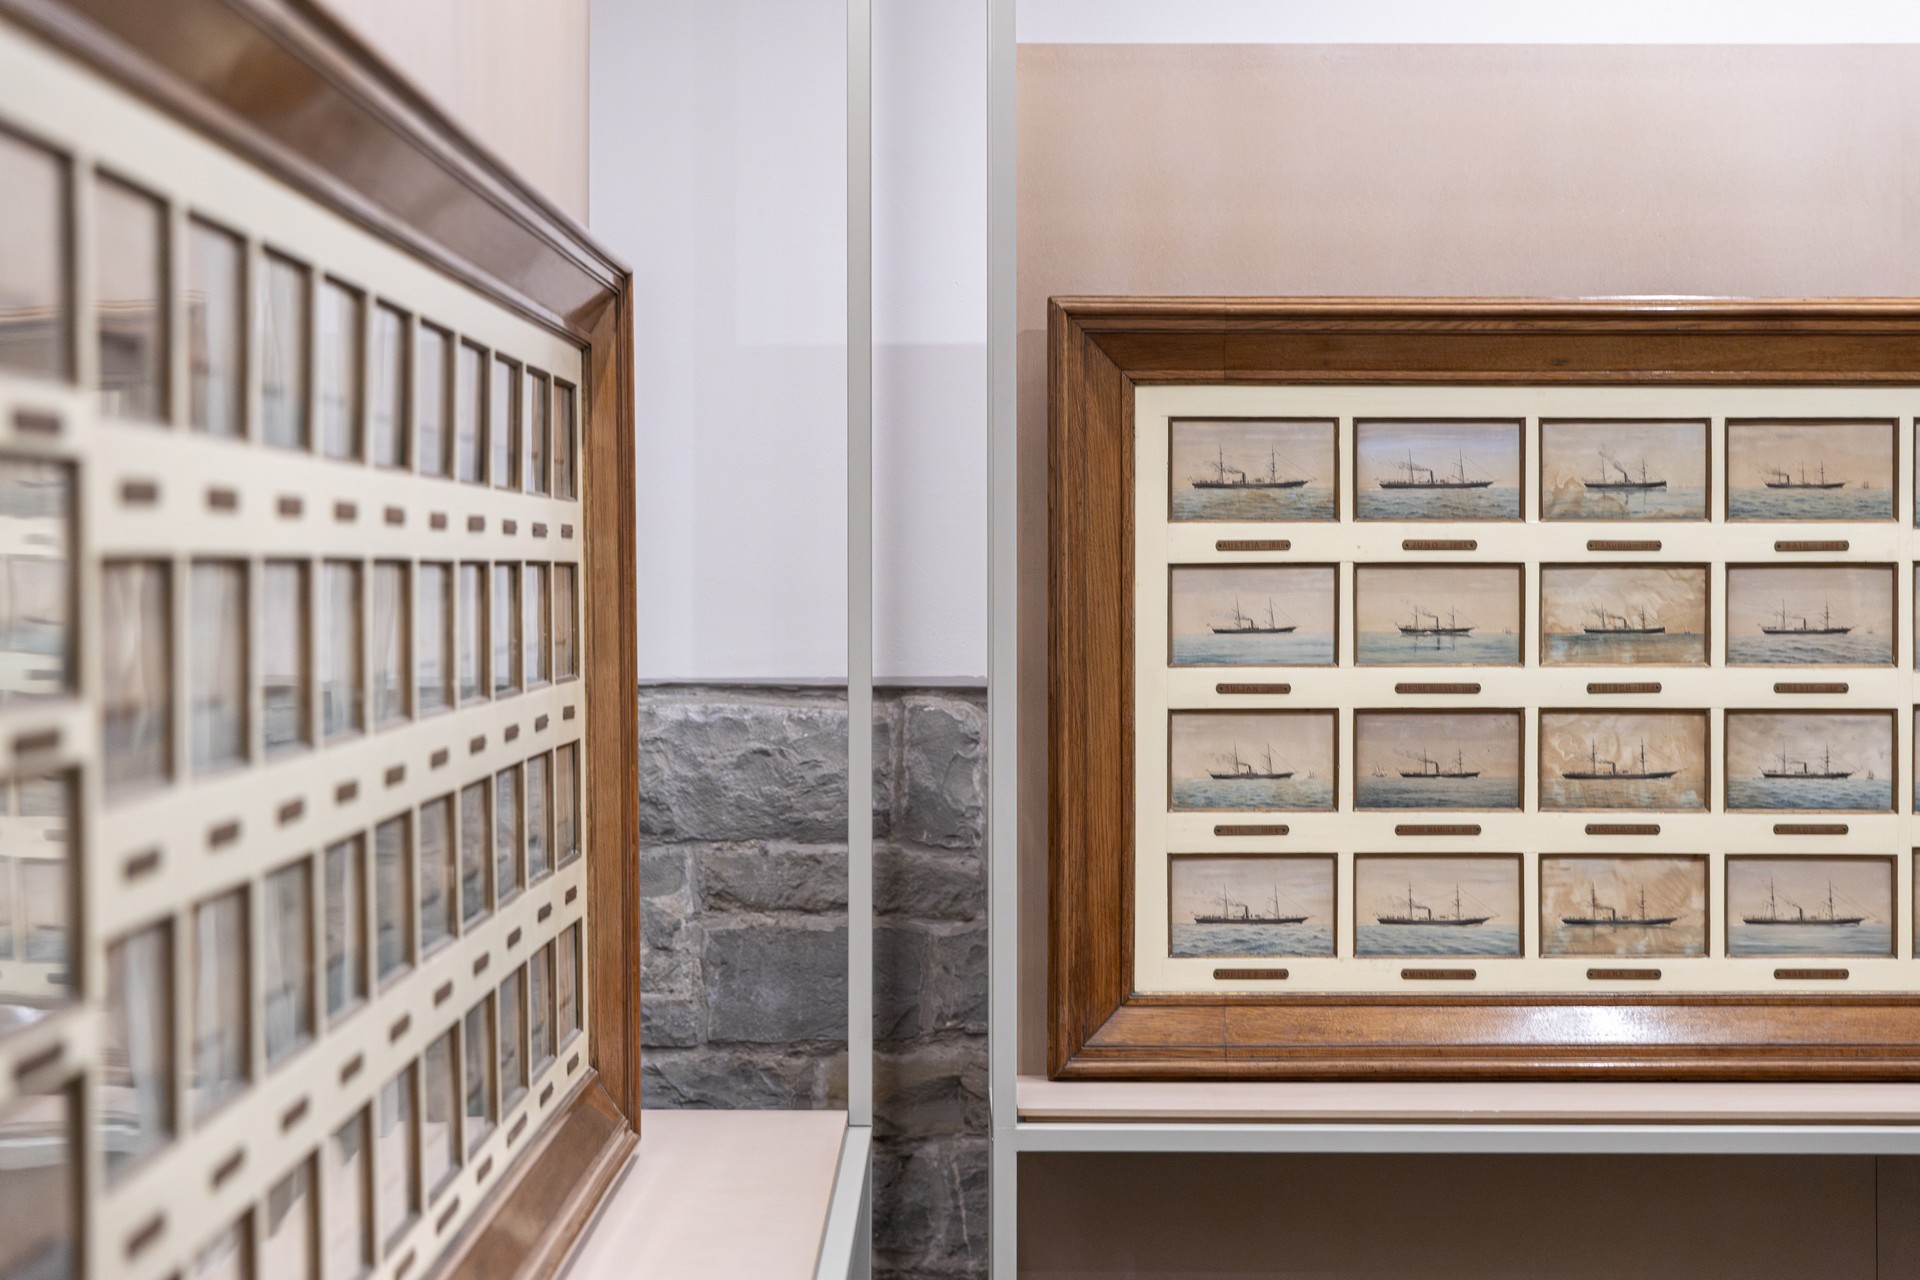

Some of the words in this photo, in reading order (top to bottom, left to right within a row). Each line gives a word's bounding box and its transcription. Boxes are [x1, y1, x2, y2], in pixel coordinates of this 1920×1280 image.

[1222, 541, 1260, 550] AUSTRIA
[1269, 541, 1286, 549] 18
[1412, 541, 1438, 549] JUNO
[1450, 541, 1467, 549] 18
[1823, 541, 1839, 549] 18
[1409, 970, 1445, 978] MINERVA
